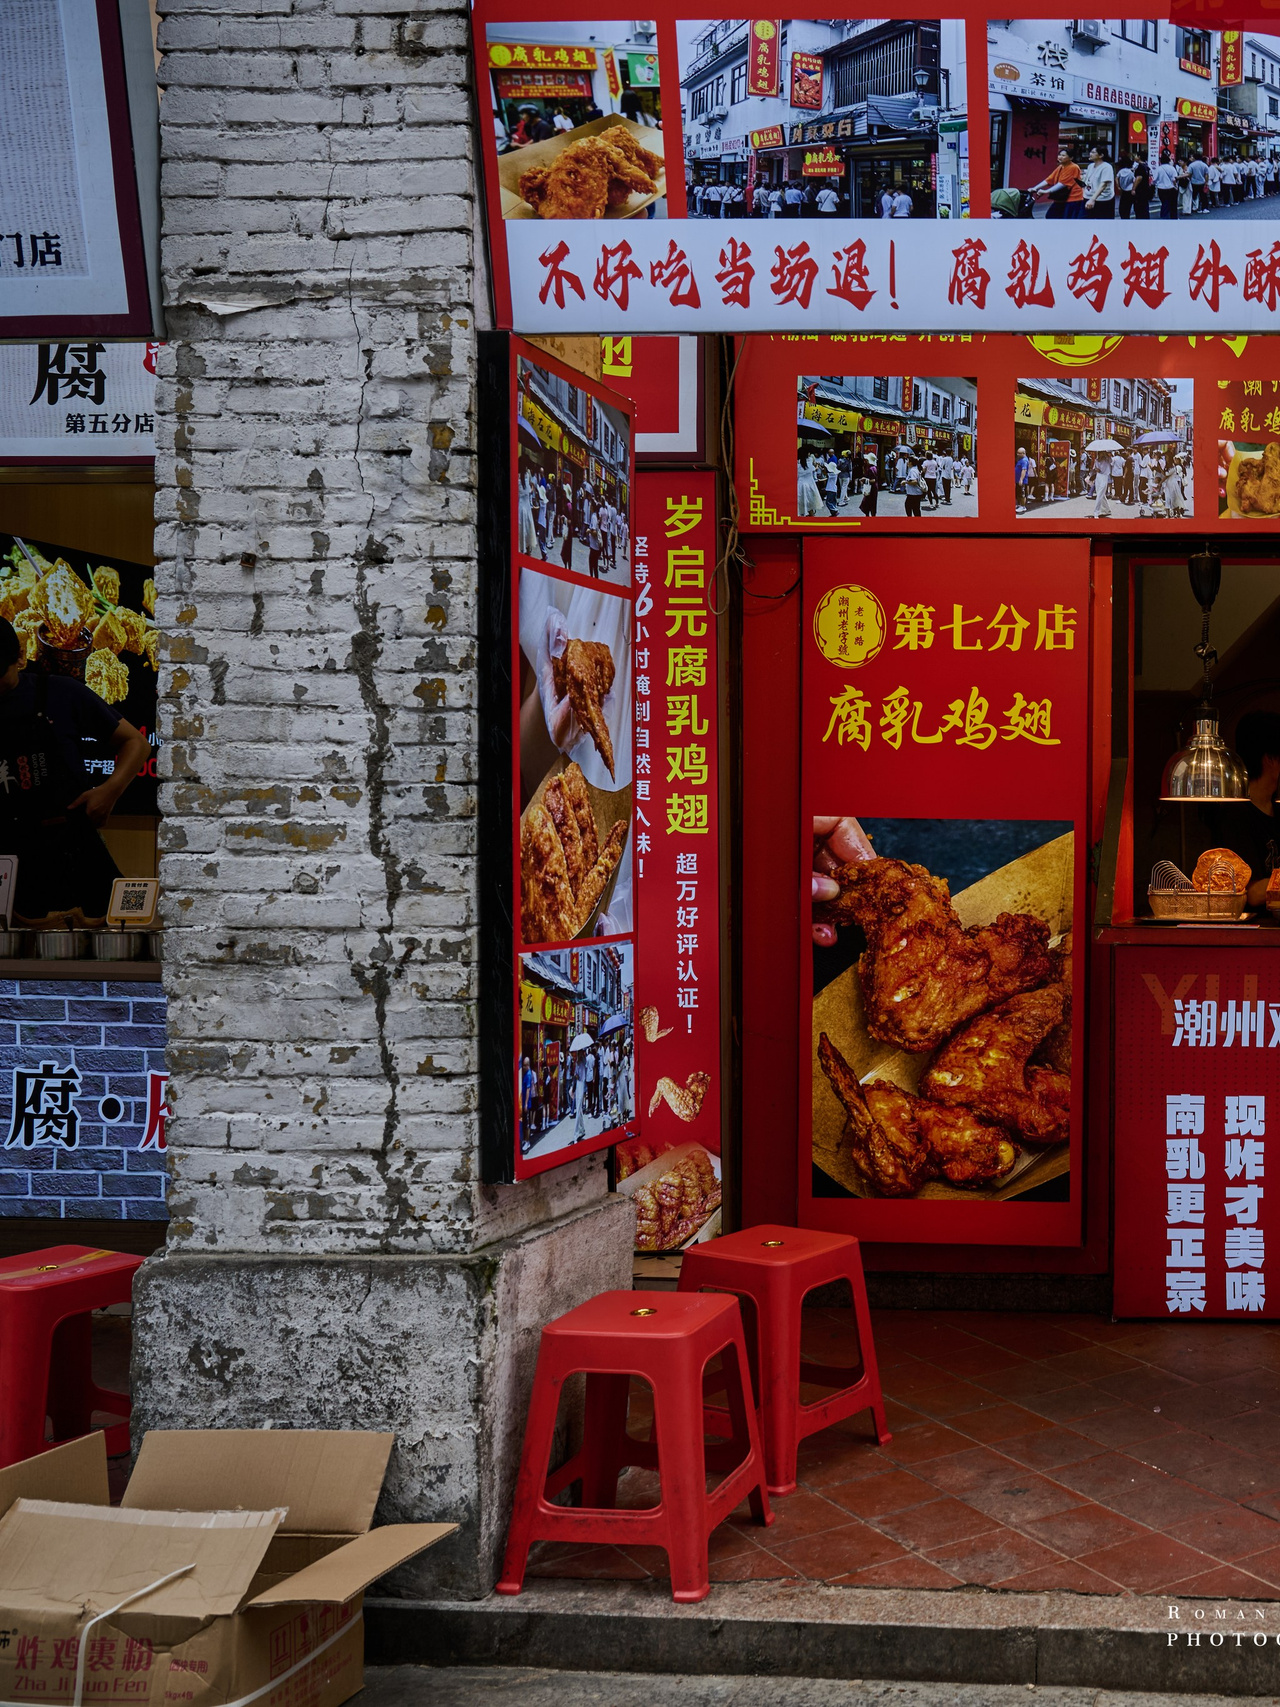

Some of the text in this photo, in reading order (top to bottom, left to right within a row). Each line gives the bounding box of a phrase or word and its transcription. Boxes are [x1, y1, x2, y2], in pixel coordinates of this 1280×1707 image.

[65, 413, 155, 434] 第五分店
[892, 603, 1078, 652] 第七分店
[663, 495, 710, 835] 岁启元腐乳鸡翅
[822, 684, 1061, 752] 腐乳鸡翅
[676, 852, 699, 1034] 超万好评认证！
[1165, 1094, 1207, 1314] 南乳更正宗
[1224, 1095, 1266, 1313] 现炸才美味
[14, 1675, 47, 1692] Zha
[113, 1677, 147, 1693] Fen
[15, 1635, 154, 1672] 炸鸡裹粉
